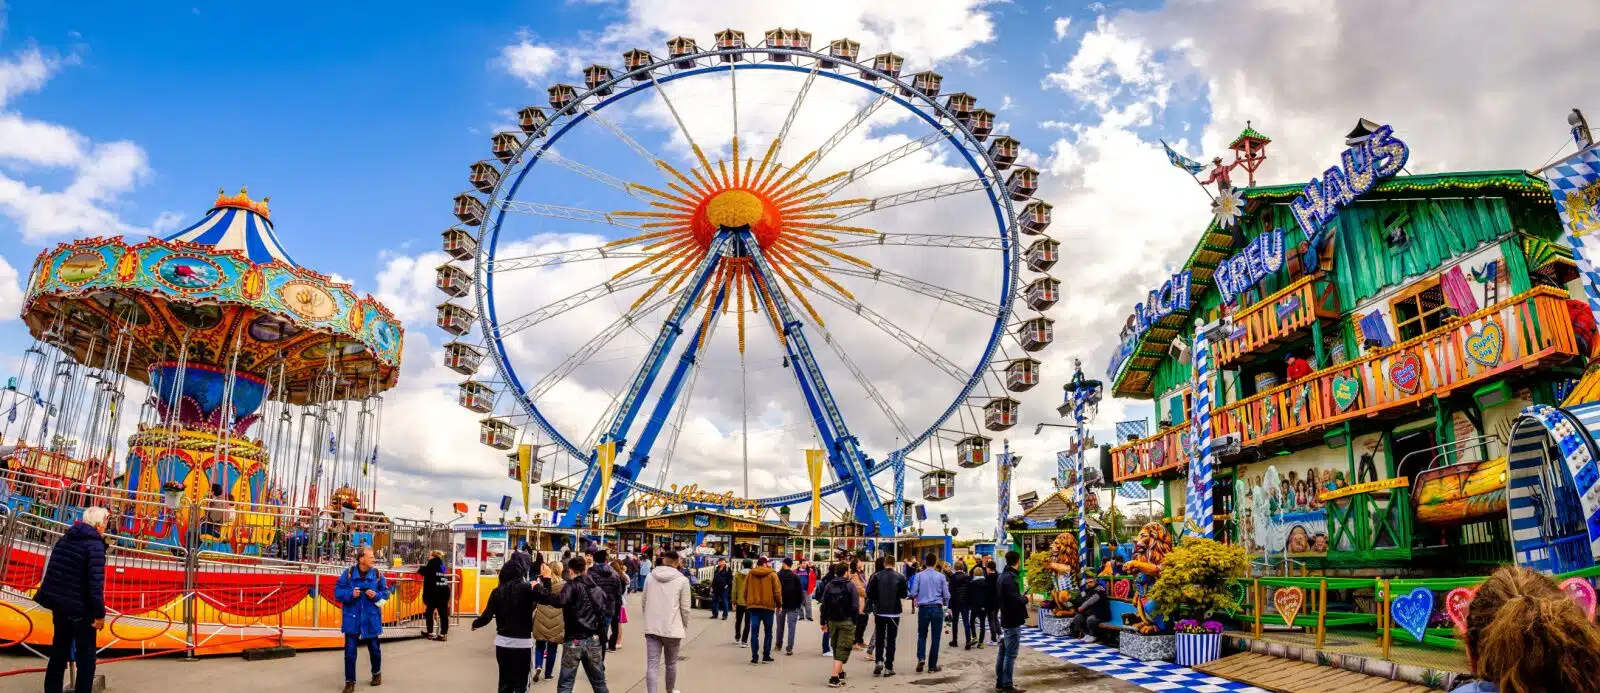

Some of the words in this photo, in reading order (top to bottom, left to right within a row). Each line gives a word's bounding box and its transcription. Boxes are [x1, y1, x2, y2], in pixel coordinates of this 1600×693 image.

[1133, 269, 1193, 341] LACH
[1213, 227, 1285, 306] FREU
[1289, 124, 1410, 241] HAUS
[1473, 332, 1494, 351] Super
[635, 483, 765, 516] Willenborg
[648, 519, 668, 527] KASSE
